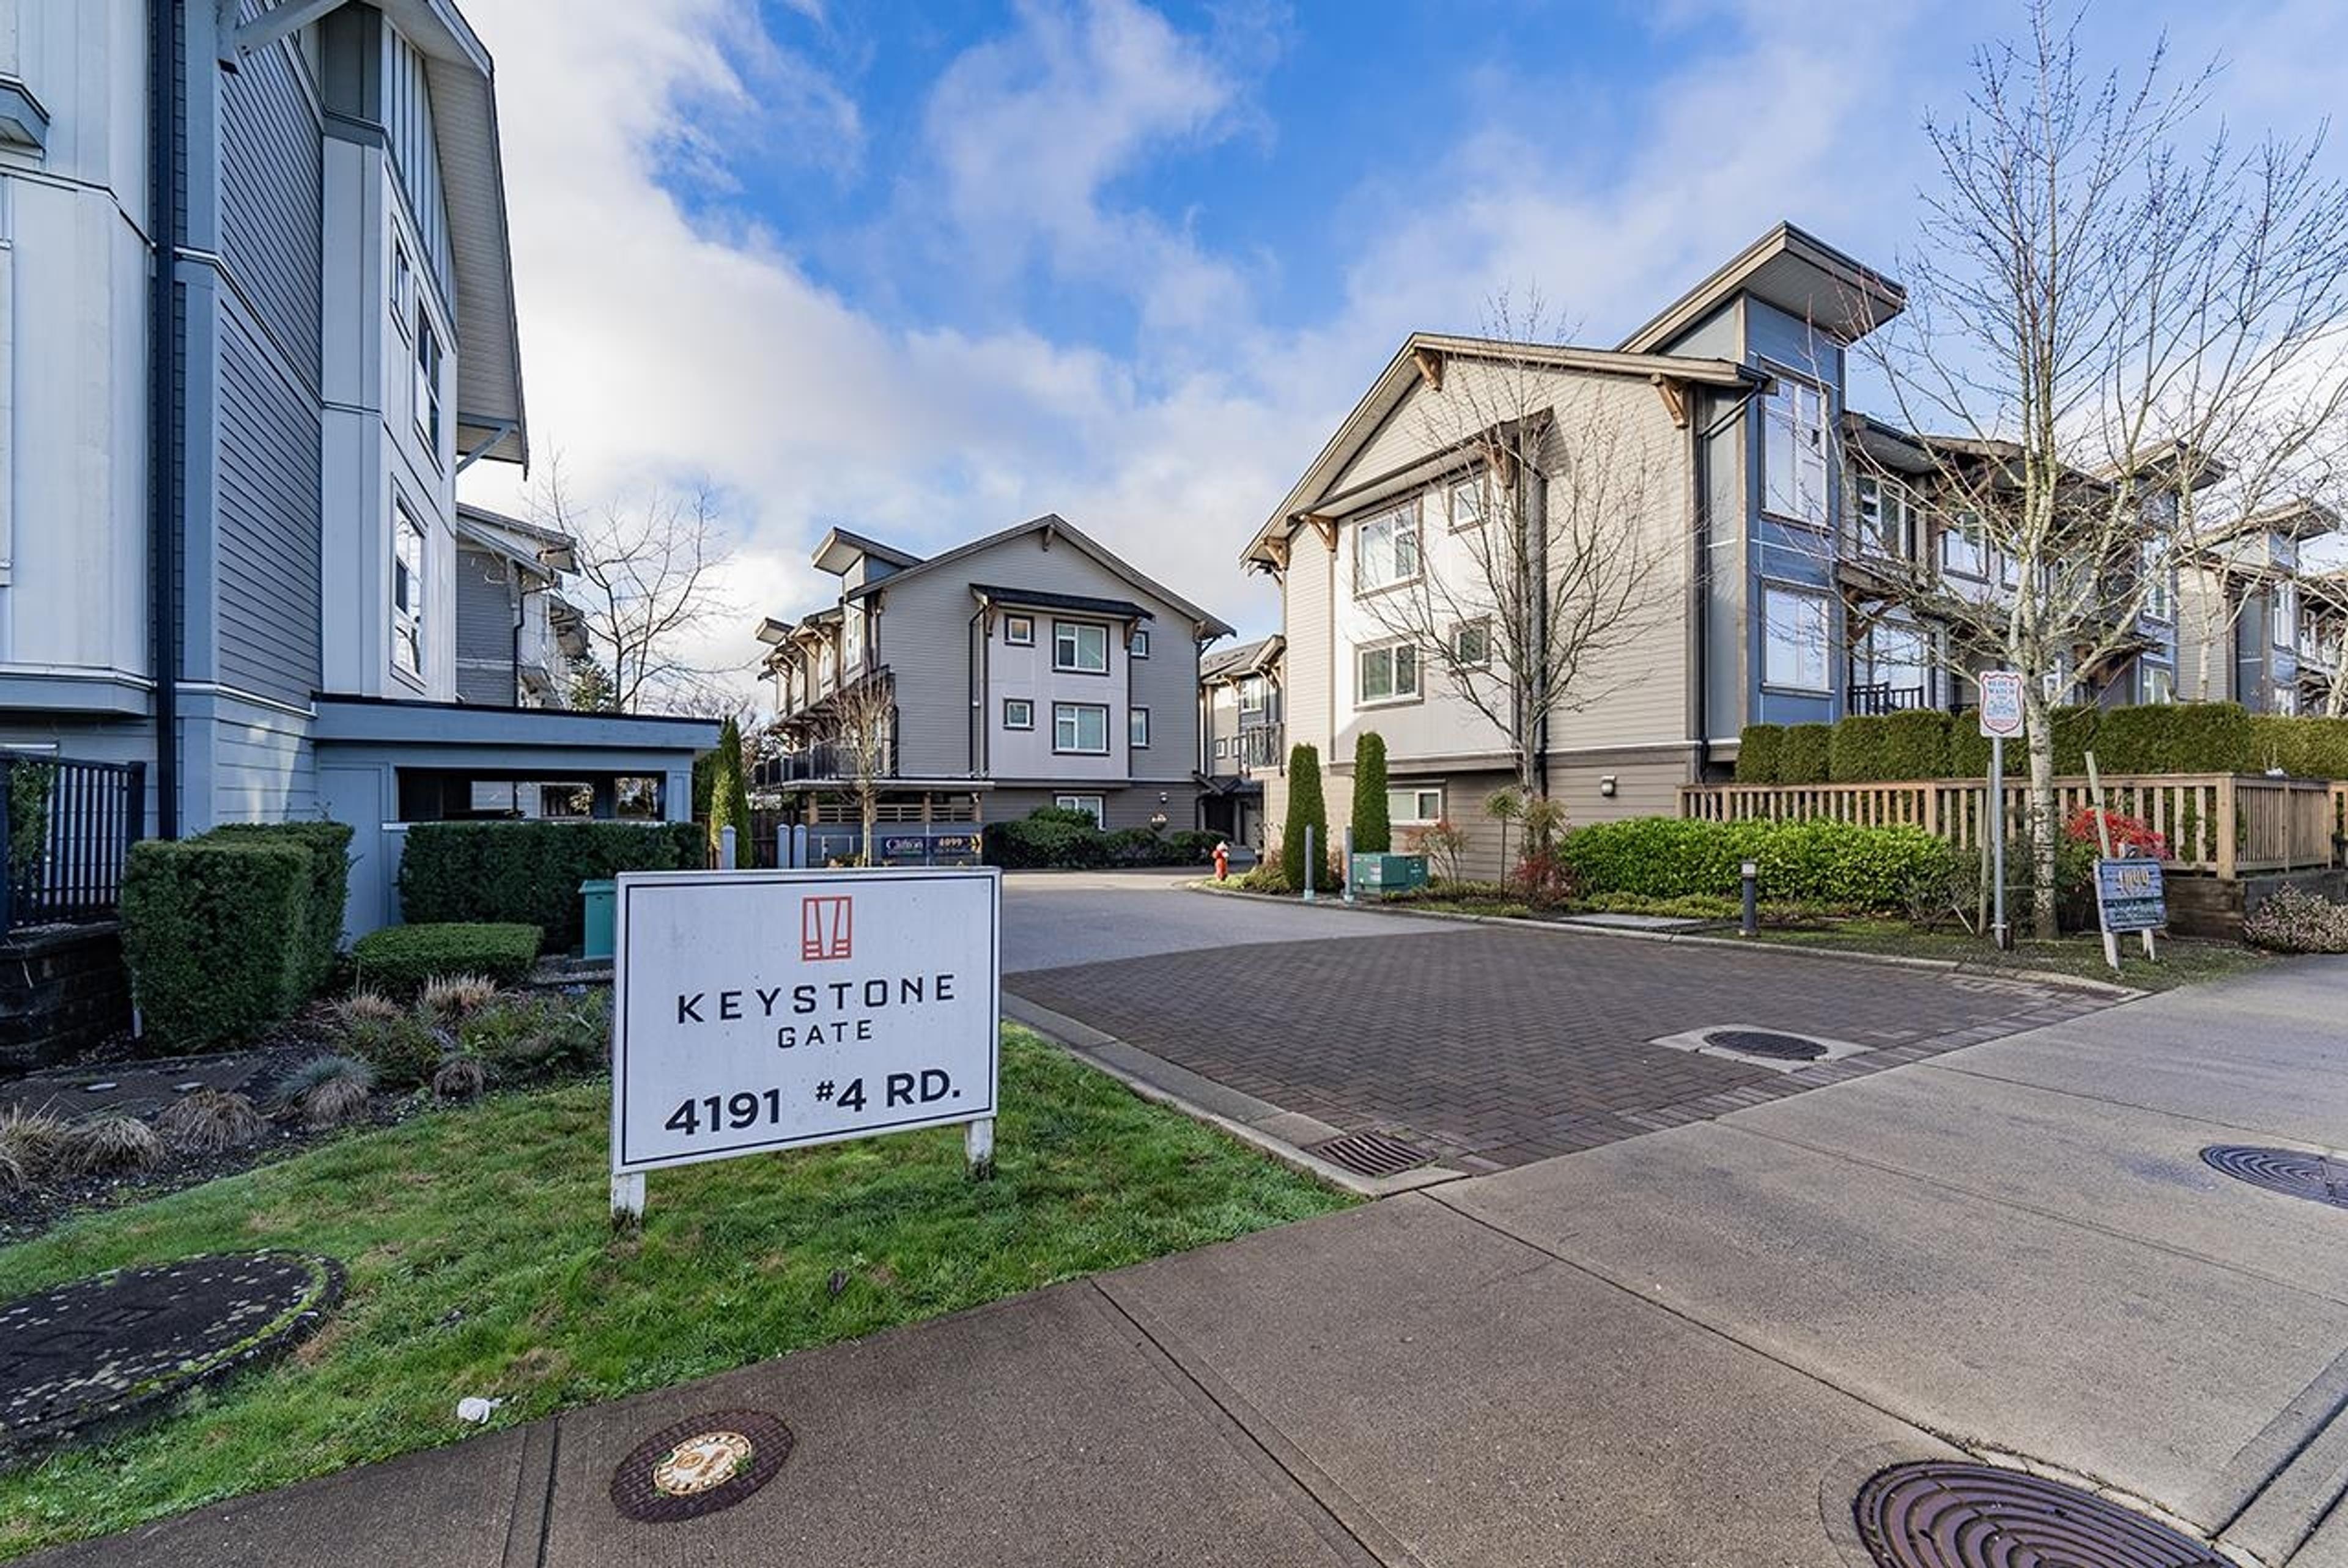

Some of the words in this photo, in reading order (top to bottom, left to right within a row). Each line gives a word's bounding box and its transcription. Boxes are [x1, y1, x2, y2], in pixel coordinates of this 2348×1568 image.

[678, 974, 954, 1024] KEYSTONE
[778, 1019, 873, 1048] GATE
[665, 1089, 780, 1135] 4191
[815, 1078, 868, 1112] #4
[887, 1069, 960, 1108] RD.
